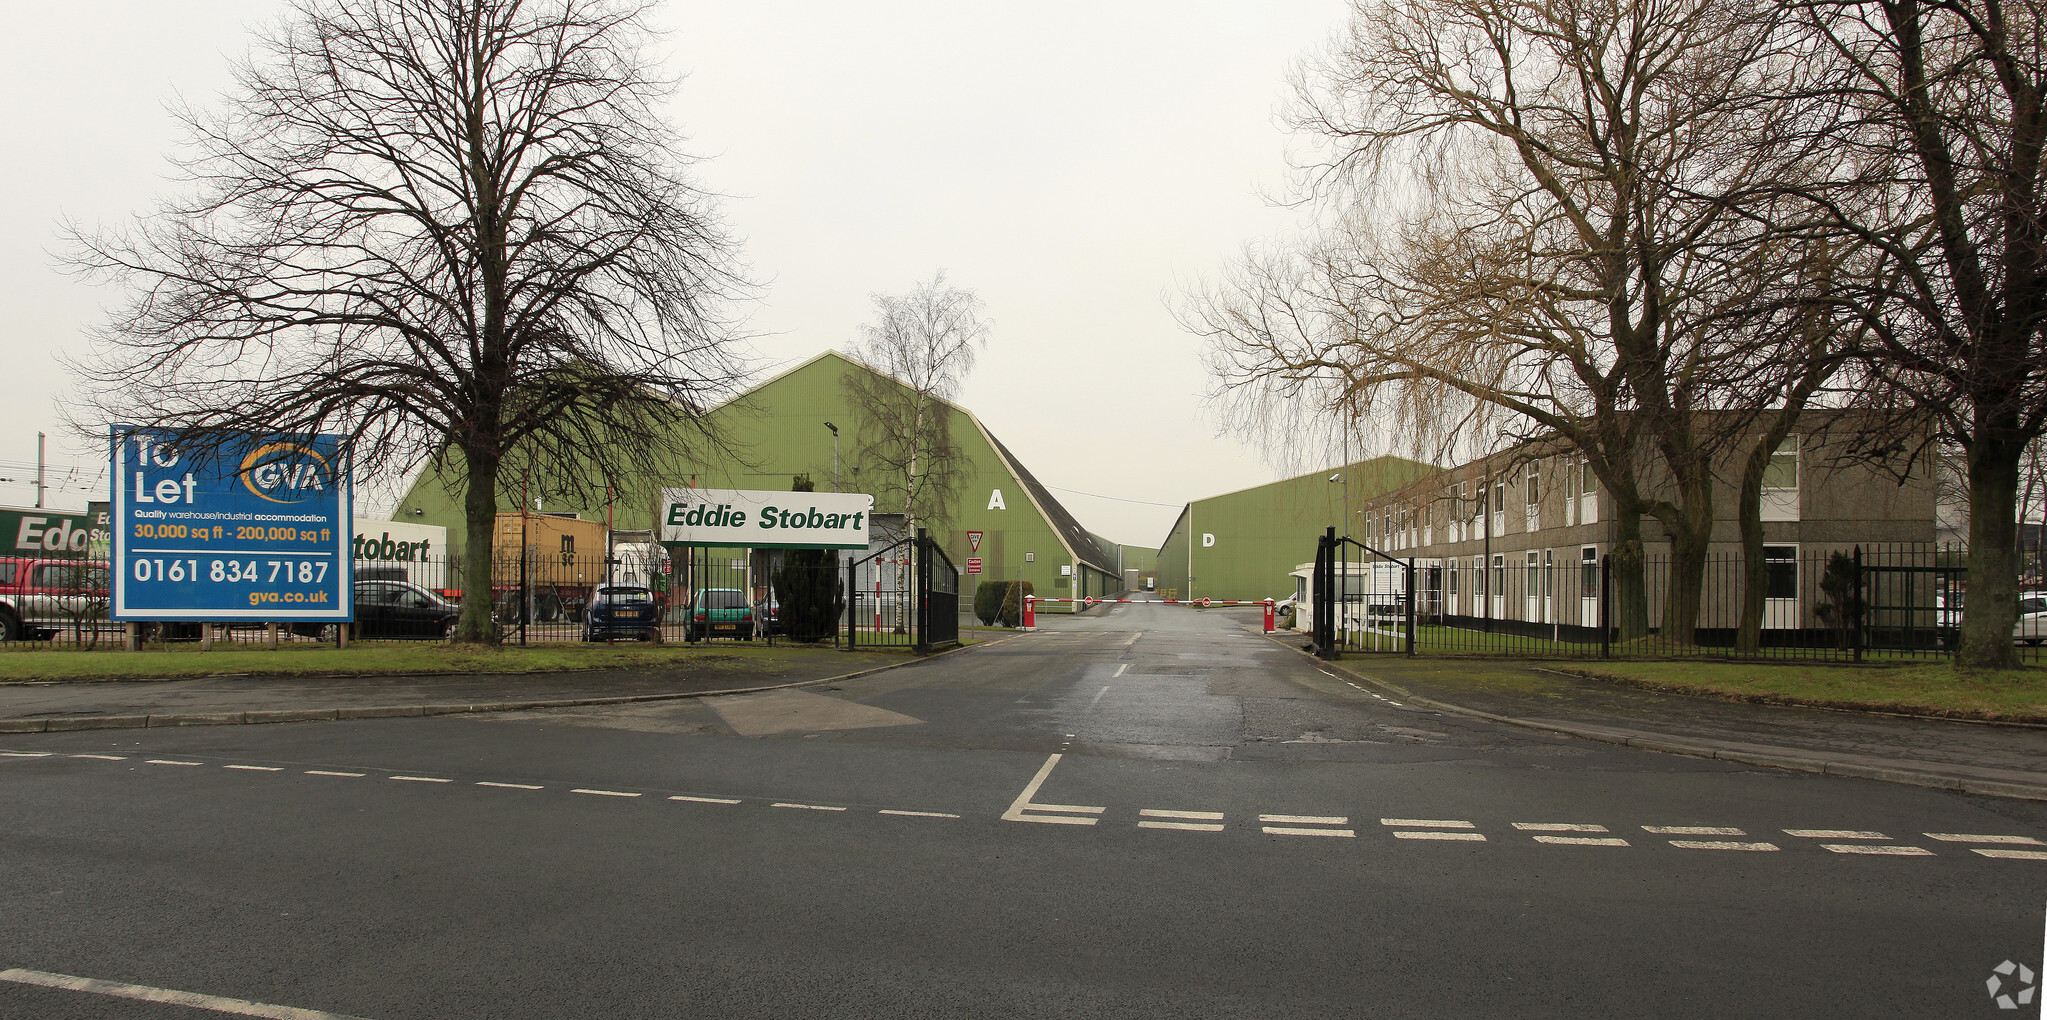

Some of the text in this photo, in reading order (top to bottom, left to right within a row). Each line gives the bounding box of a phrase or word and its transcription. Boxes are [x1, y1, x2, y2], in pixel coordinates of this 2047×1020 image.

[134, 434, 179, 468] To
[135, 471, 197, 504] Let
[254, 462, 324, 491] GVA
[986, 489, 1007, 510] A
[134, 509, 327, 523] Quality warehouse/industrial accommodation
[667, 503, 864, 530] Eddie Stobart
[134, 524, 188, 540] 30,000
[191, 527, 209, 541] sq
[212, 526, 224, 539] ft
[236, 526, 297, 542] 200,000
[300, 530, 317, 544] sq
[320, 528, 331, 541] ft
[1202, 532, 1216, 548] D
[134, 558, 329, 583] 0161 834 7187
[248, 590, 328, 606] gva.co.uk
